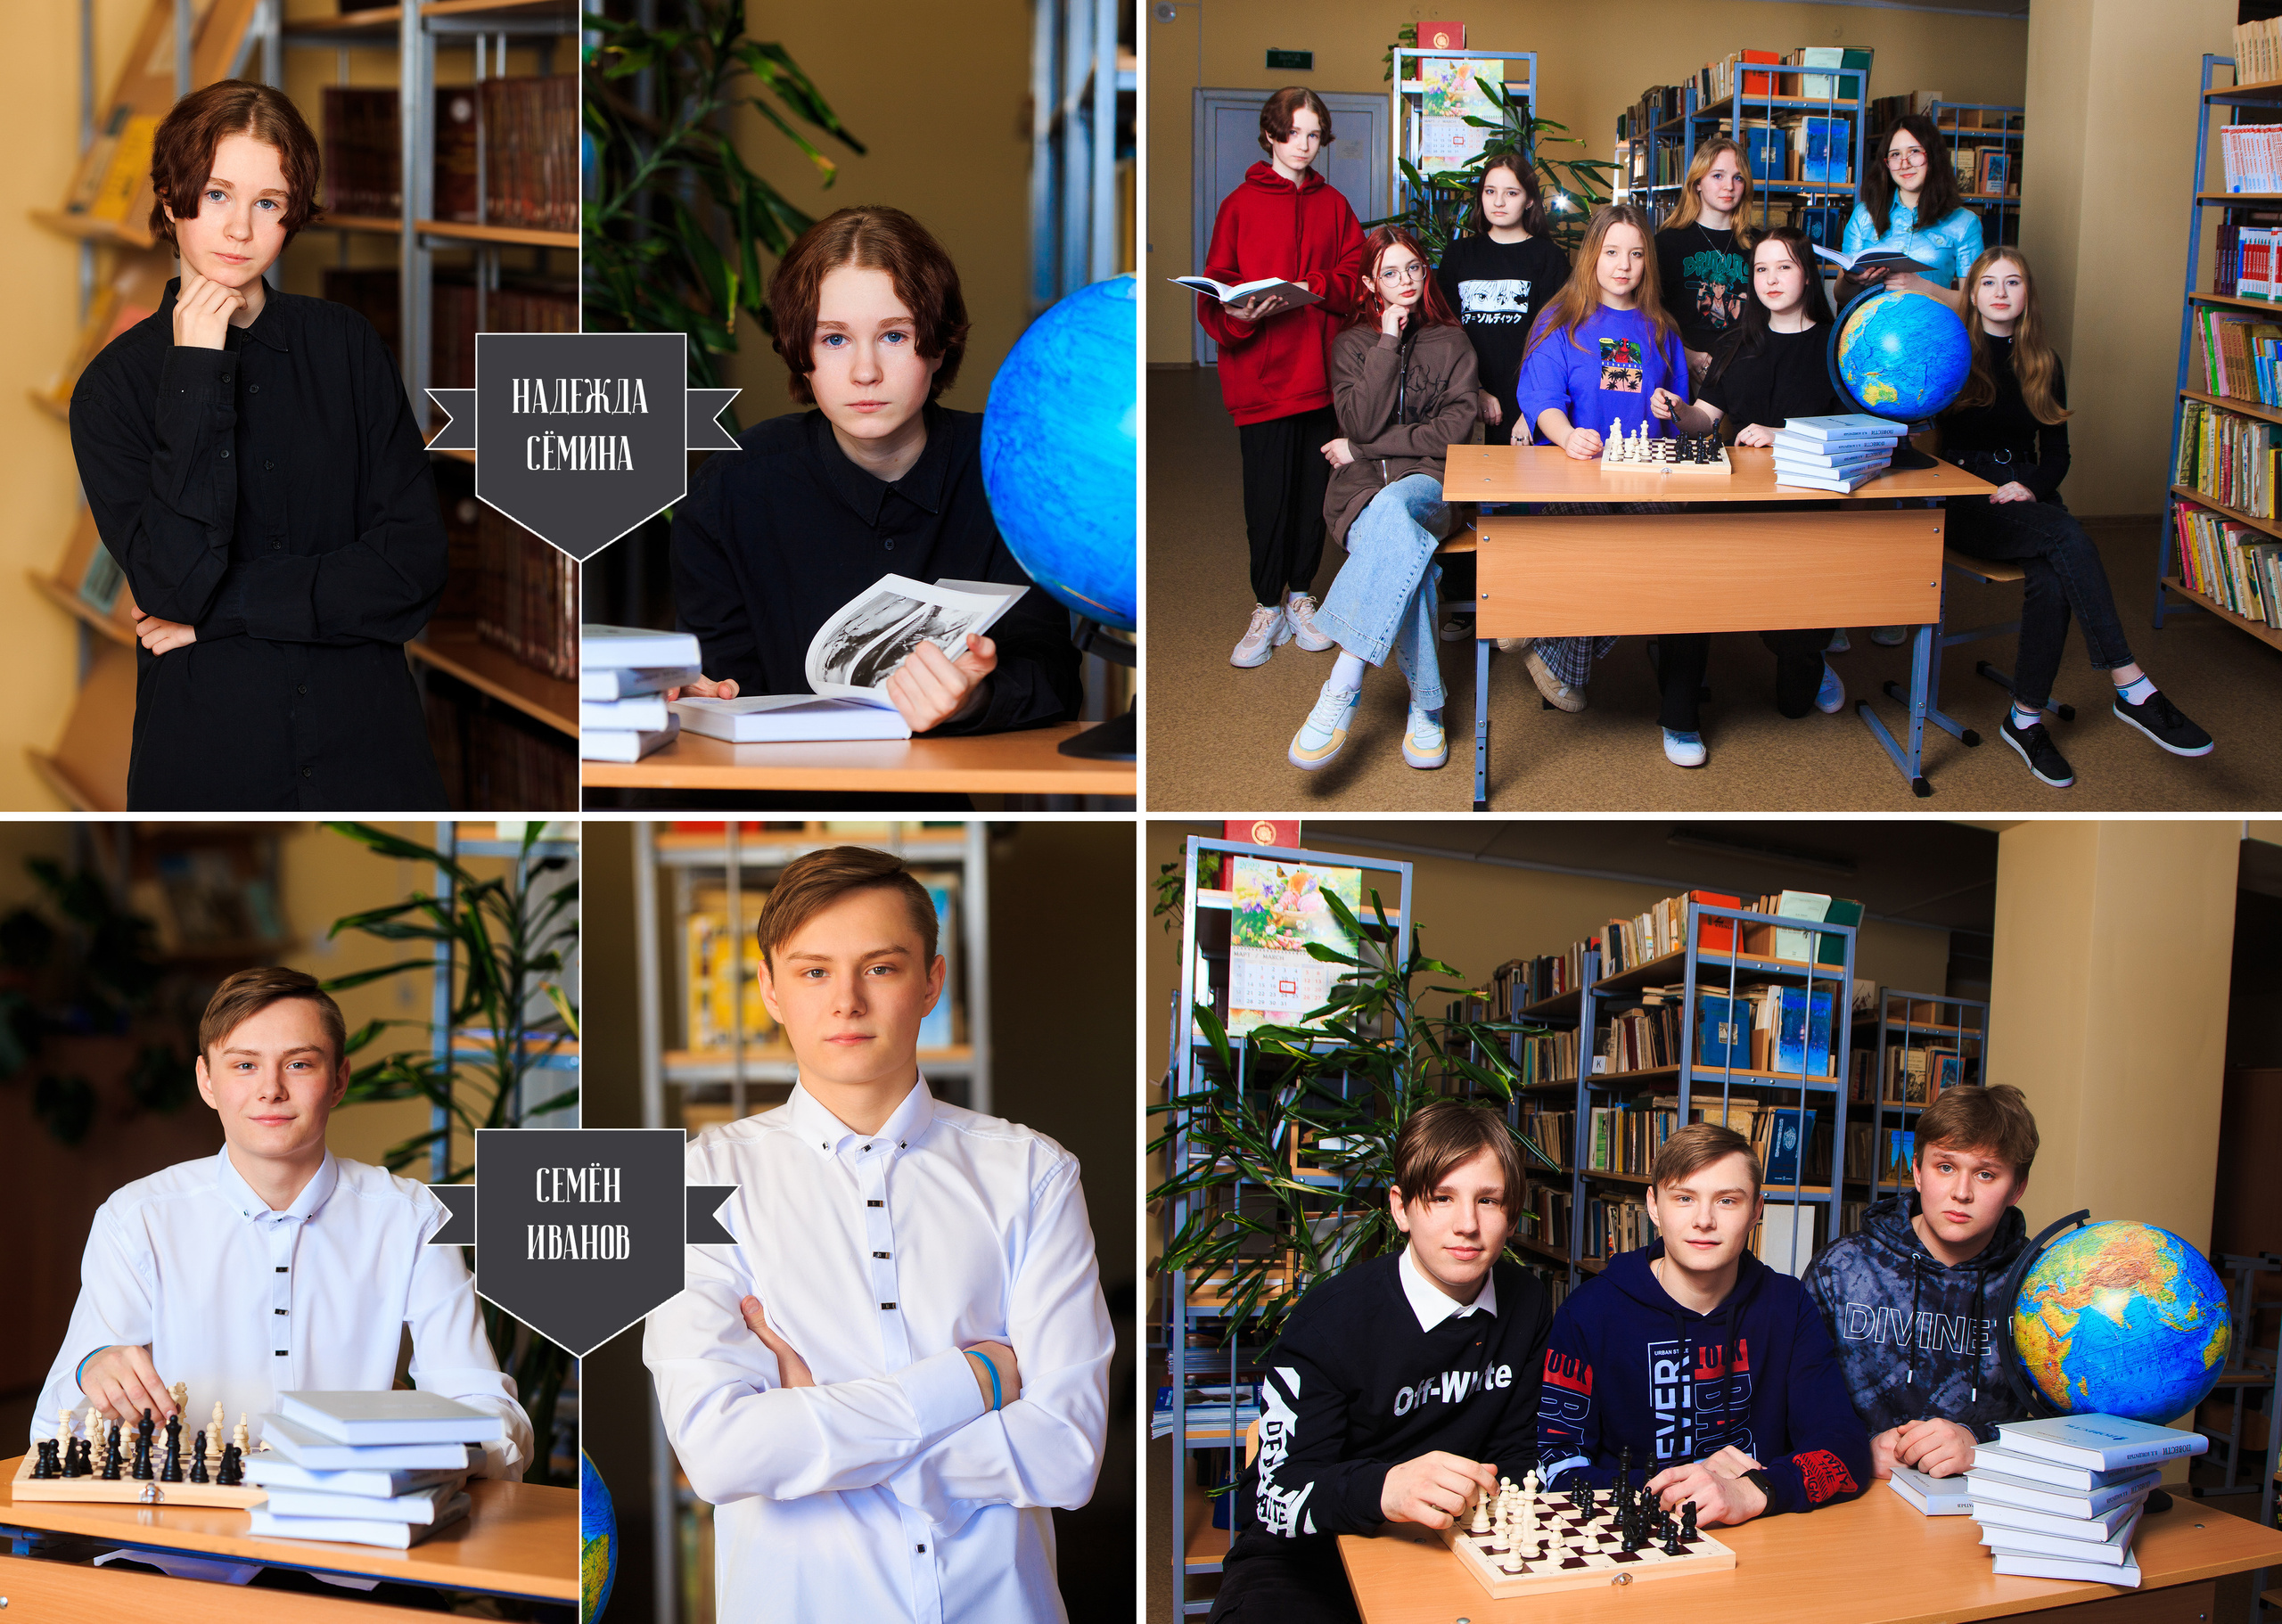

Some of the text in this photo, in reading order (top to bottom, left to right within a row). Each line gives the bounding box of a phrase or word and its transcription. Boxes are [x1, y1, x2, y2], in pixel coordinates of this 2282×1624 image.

[1843, 1302, 1991, 1356] DIVINE
[1544, 1349, 1588, 1385] OOK
[2162, 1444, 2192, 1456] ПОВЕСТИ
[1794, 1459, 1820, 1499] DESIGN
[1818, 1461, 1835, 1484] THE
[1823, 1454, 1849, 1486] WHY
